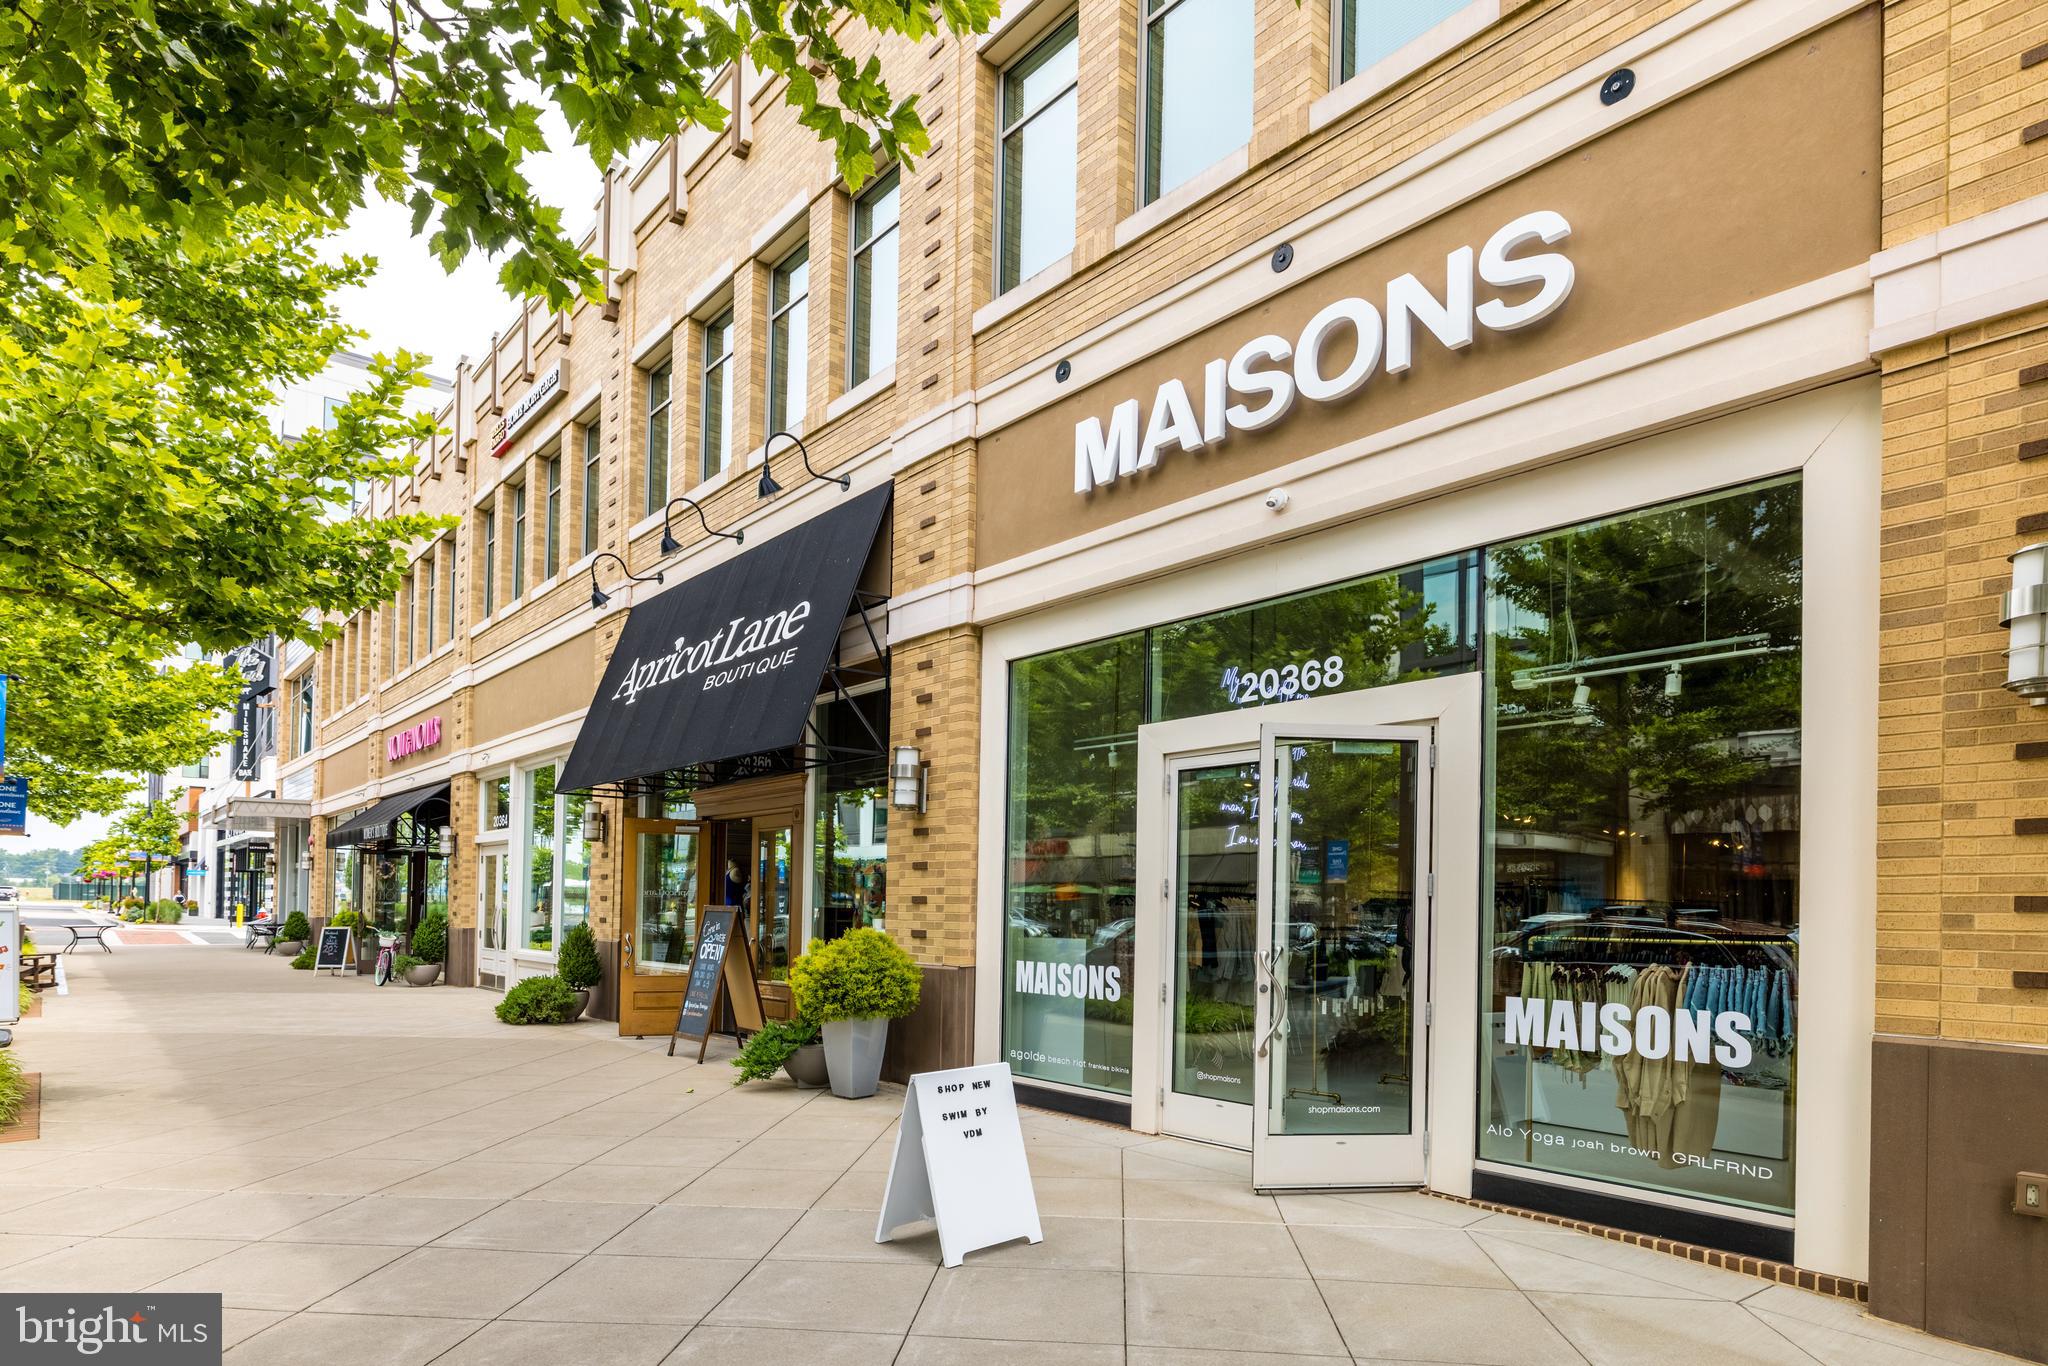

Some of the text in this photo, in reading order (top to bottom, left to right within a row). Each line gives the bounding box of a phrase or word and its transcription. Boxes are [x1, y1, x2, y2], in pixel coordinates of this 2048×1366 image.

[1075, 211, 1575, 494] MAISONS
[703, 647, 799, 691] BOUTIQUE
[1241, 656, 1344, 703] 20368
[239, 769, 252, 777] BAR
[1016, 960, 1121, 1002] MAISONS
[1505, 996, 1752, 1068] MAISONS
[1010, 1049, 1130, 1074] agolde beach riot frankies bikinis
[937, 1080, 991, 1094] SHOP NEW
[1197, 1071, 1241, 1084] @shopmaisons
[942, 1107, 988, 1121] SWIM BY
[1308, 1104, 1381, 1114] shopmaisons.com
[963, 1128, 983, 1139] VDM
[1486, 1124, 1513, 1137] Alo
[1519, 1127, 1565, 1146] Yoga
[1610, 1142, 1661, 1160] brown
[1672, 1152, 1773, 1179] GRLFRND
